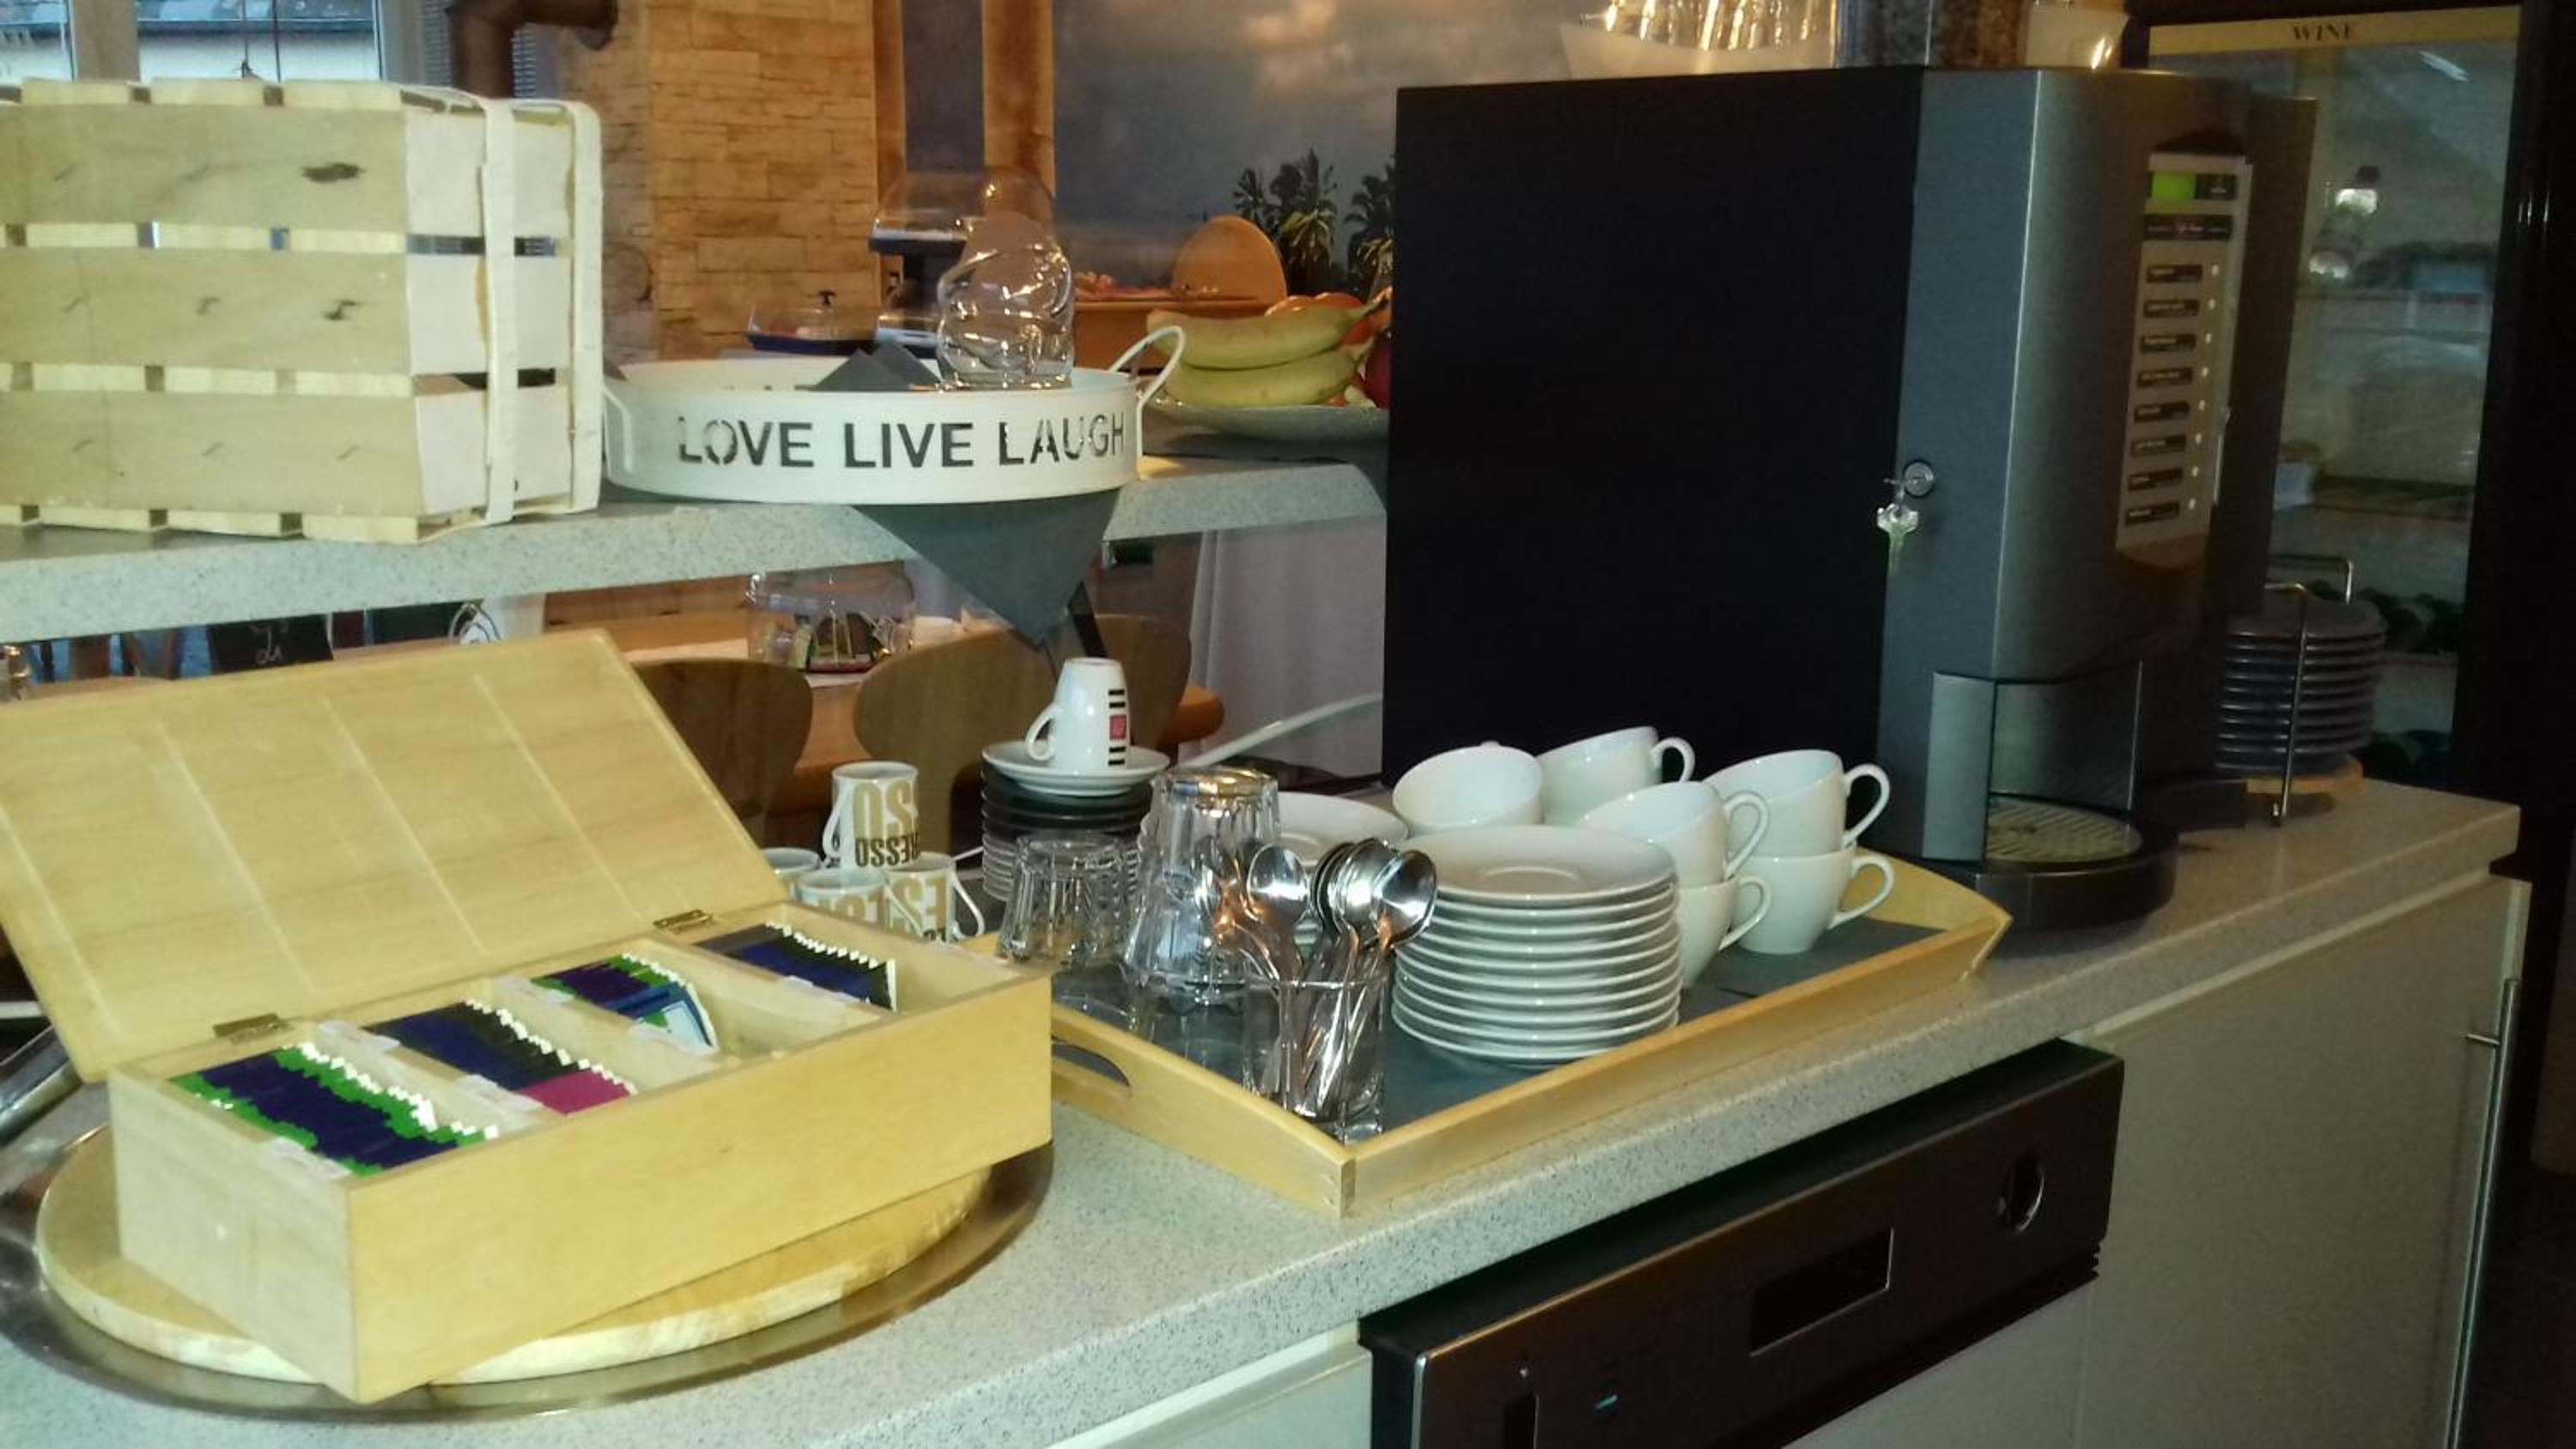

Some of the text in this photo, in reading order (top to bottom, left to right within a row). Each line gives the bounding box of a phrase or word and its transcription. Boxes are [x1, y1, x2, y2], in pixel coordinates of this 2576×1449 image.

[677, 412, 1124, 468] LOVE LIVE LAUGH
